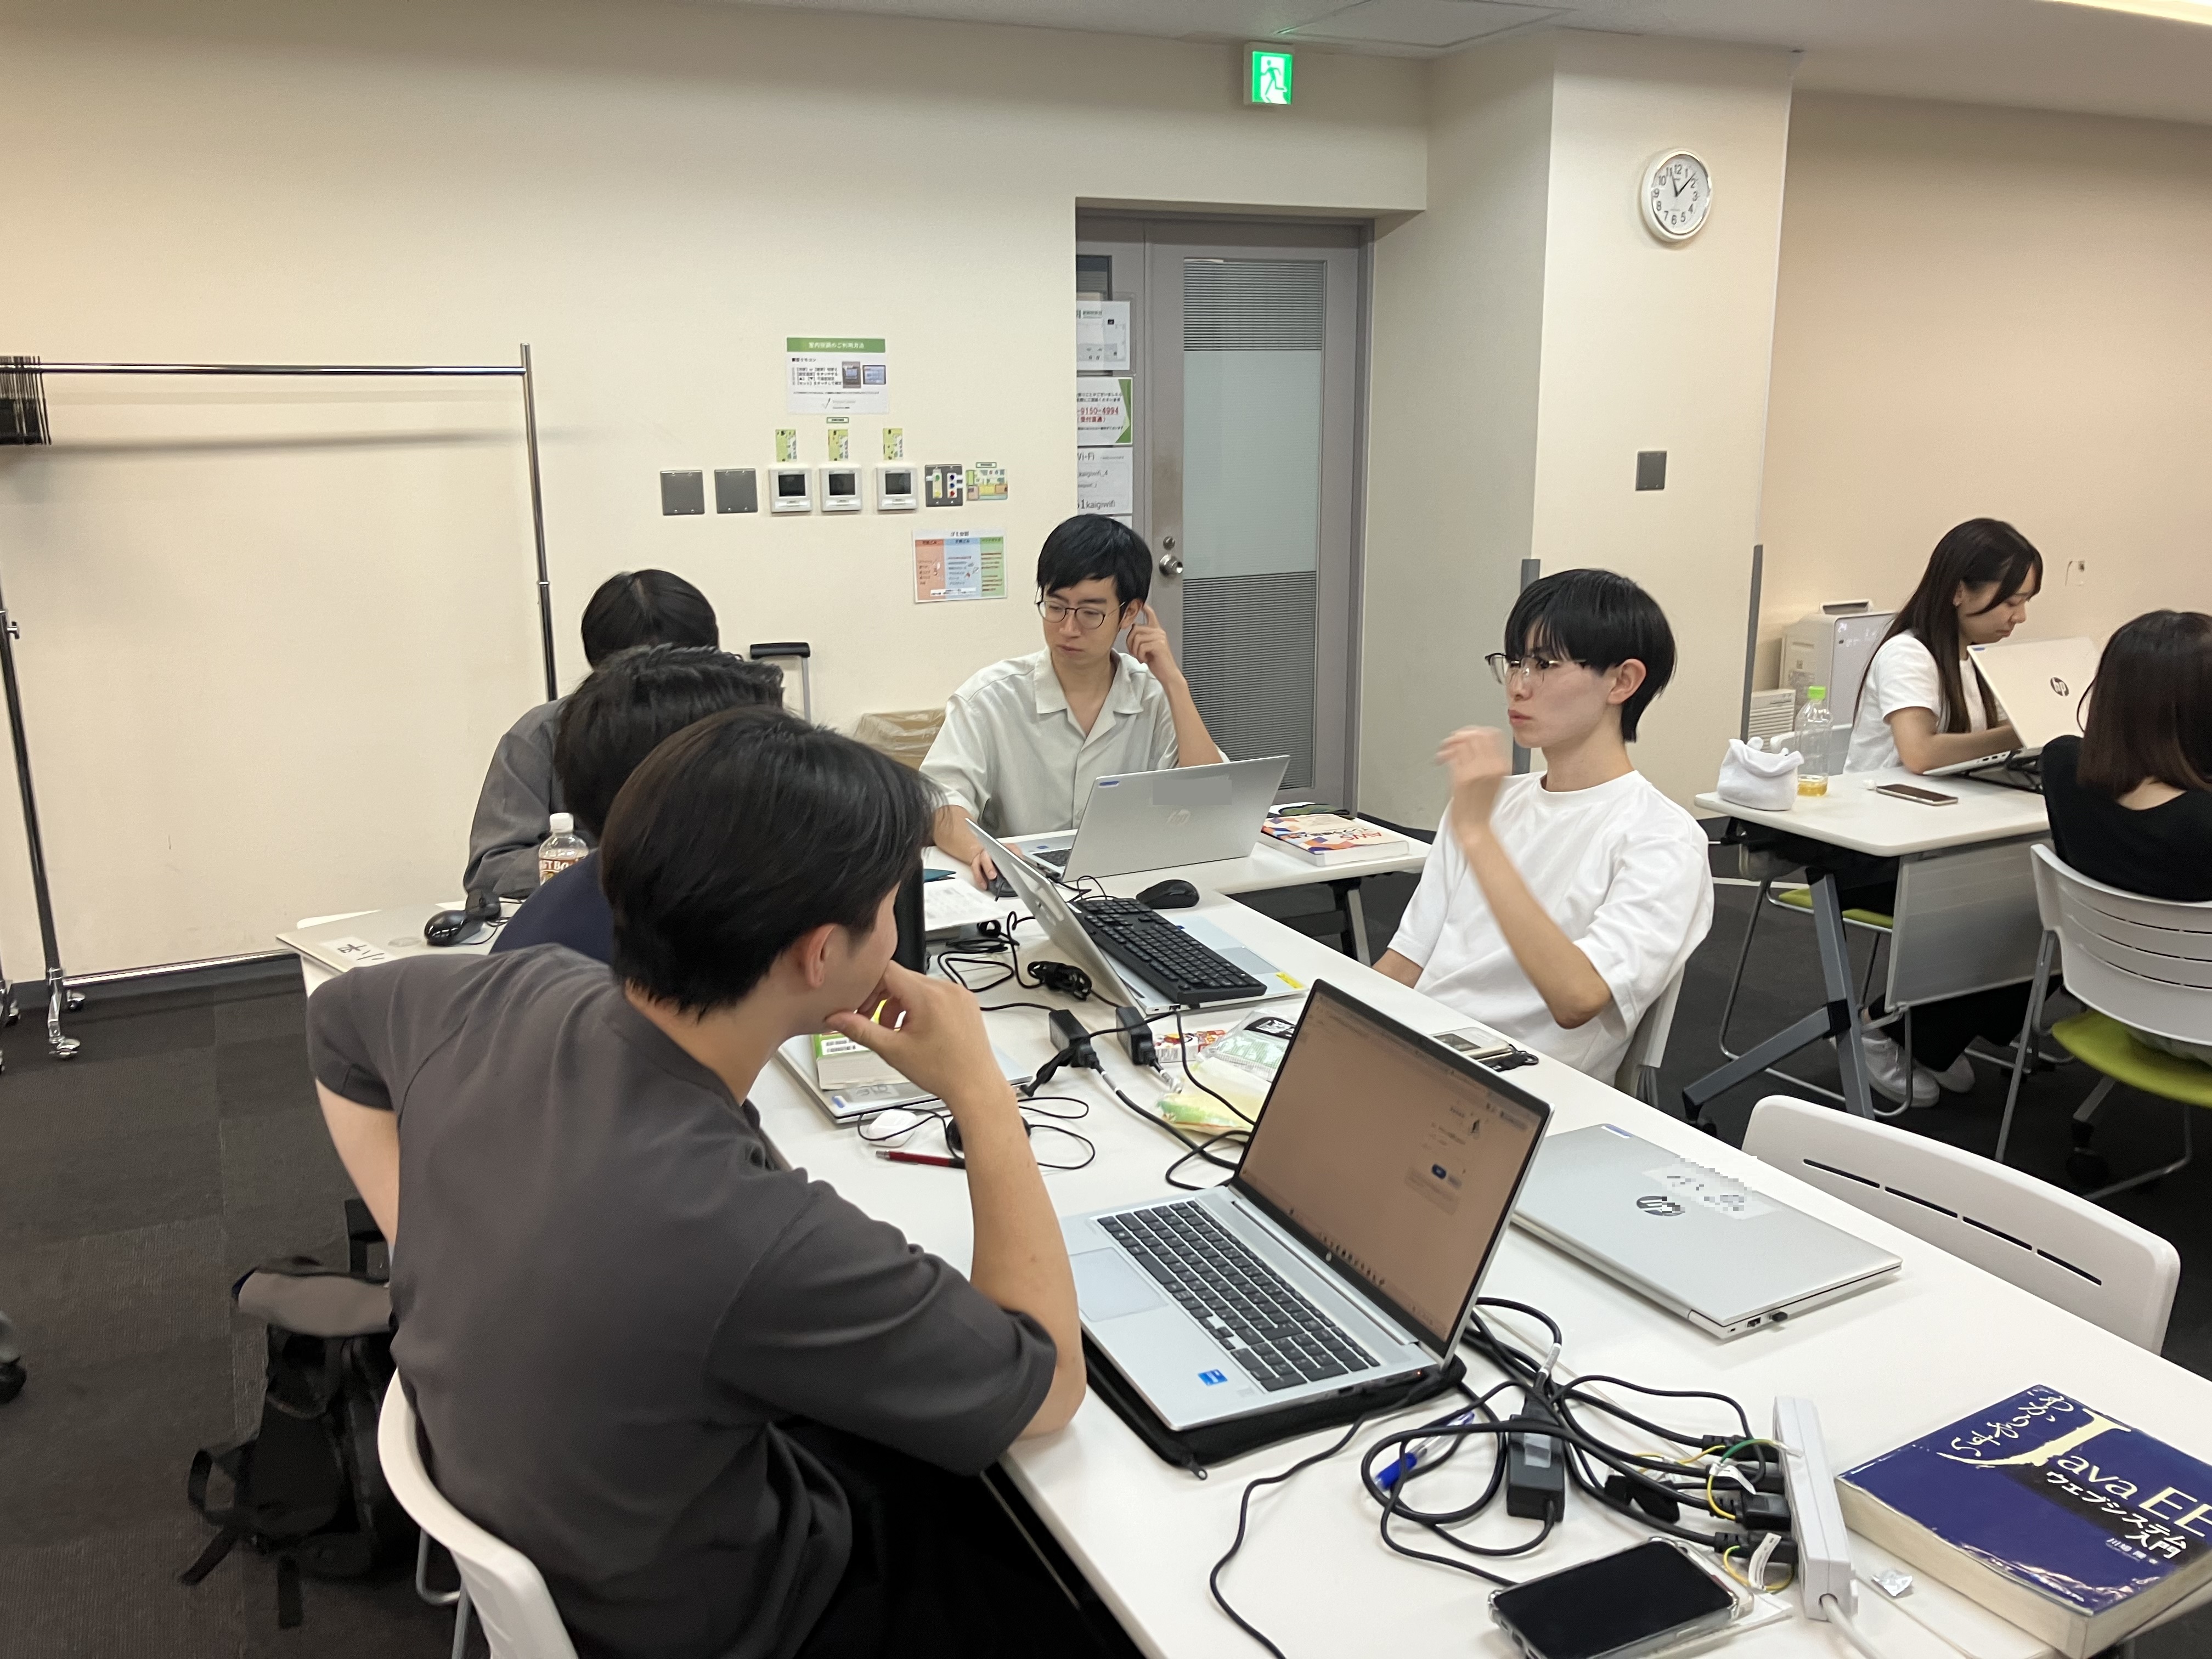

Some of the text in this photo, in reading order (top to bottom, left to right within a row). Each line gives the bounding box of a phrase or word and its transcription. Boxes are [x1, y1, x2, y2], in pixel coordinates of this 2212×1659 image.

[1666, 167, 1672, 177] 11
[1674, 164, 1682, 174] 12
[1685, 168, 1688, 178] 1
[1658, 175, 1667, 185] 10
[1690, 178, 1697, 188] 2
[1654, 188, 1660, 198] 9
[1692, 191, 1698, 201] 3
[1656, 201, 1662, 211] 8
[1688, 204, 1694, 214] 4
[1664, 211, 1669, 221] 7
[1671, 215, 1677, 225] 6
[1681, 212, 1686, 222] 5
[2050, 677, 2069, 696] hp
[1951, 1396, 2074, 1457] わかりやすい
[2046, 1471, 2187, 1549] ウェブシステム
[2139, 1486, 2212, 1537] EE
[2125, 1531, 2182, 1559] 入門
